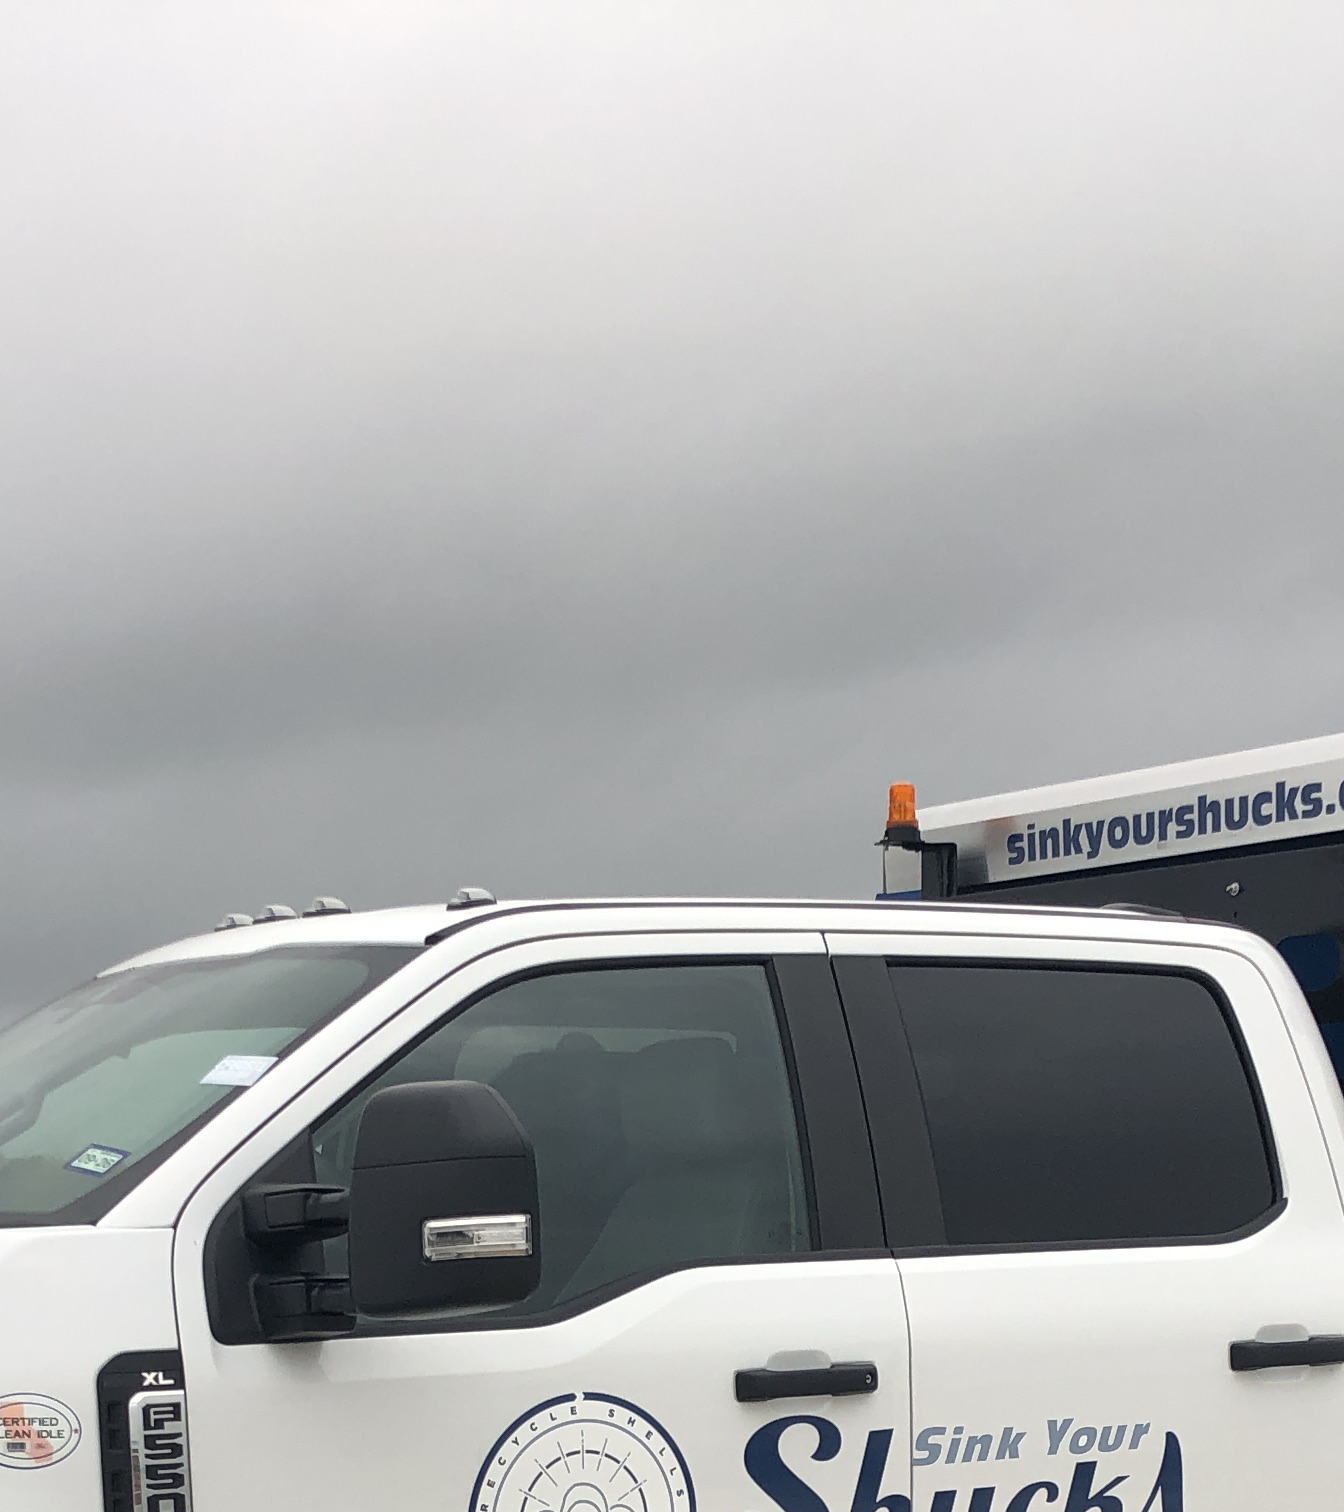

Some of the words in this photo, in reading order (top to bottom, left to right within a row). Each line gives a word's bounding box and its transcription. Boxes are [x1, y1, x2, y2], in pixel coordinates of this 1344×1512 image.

[141, 1372, 175, 1386] XL
[37, 1429, 65, 1438] IDLE
[912, 1426, 1027, 1466] Sink
[1046, 1418, 1151, 1456] Your
[480, 1406, 578, 1512] RECYCLE
[608, 1408, 684, 1498] SHELLS
